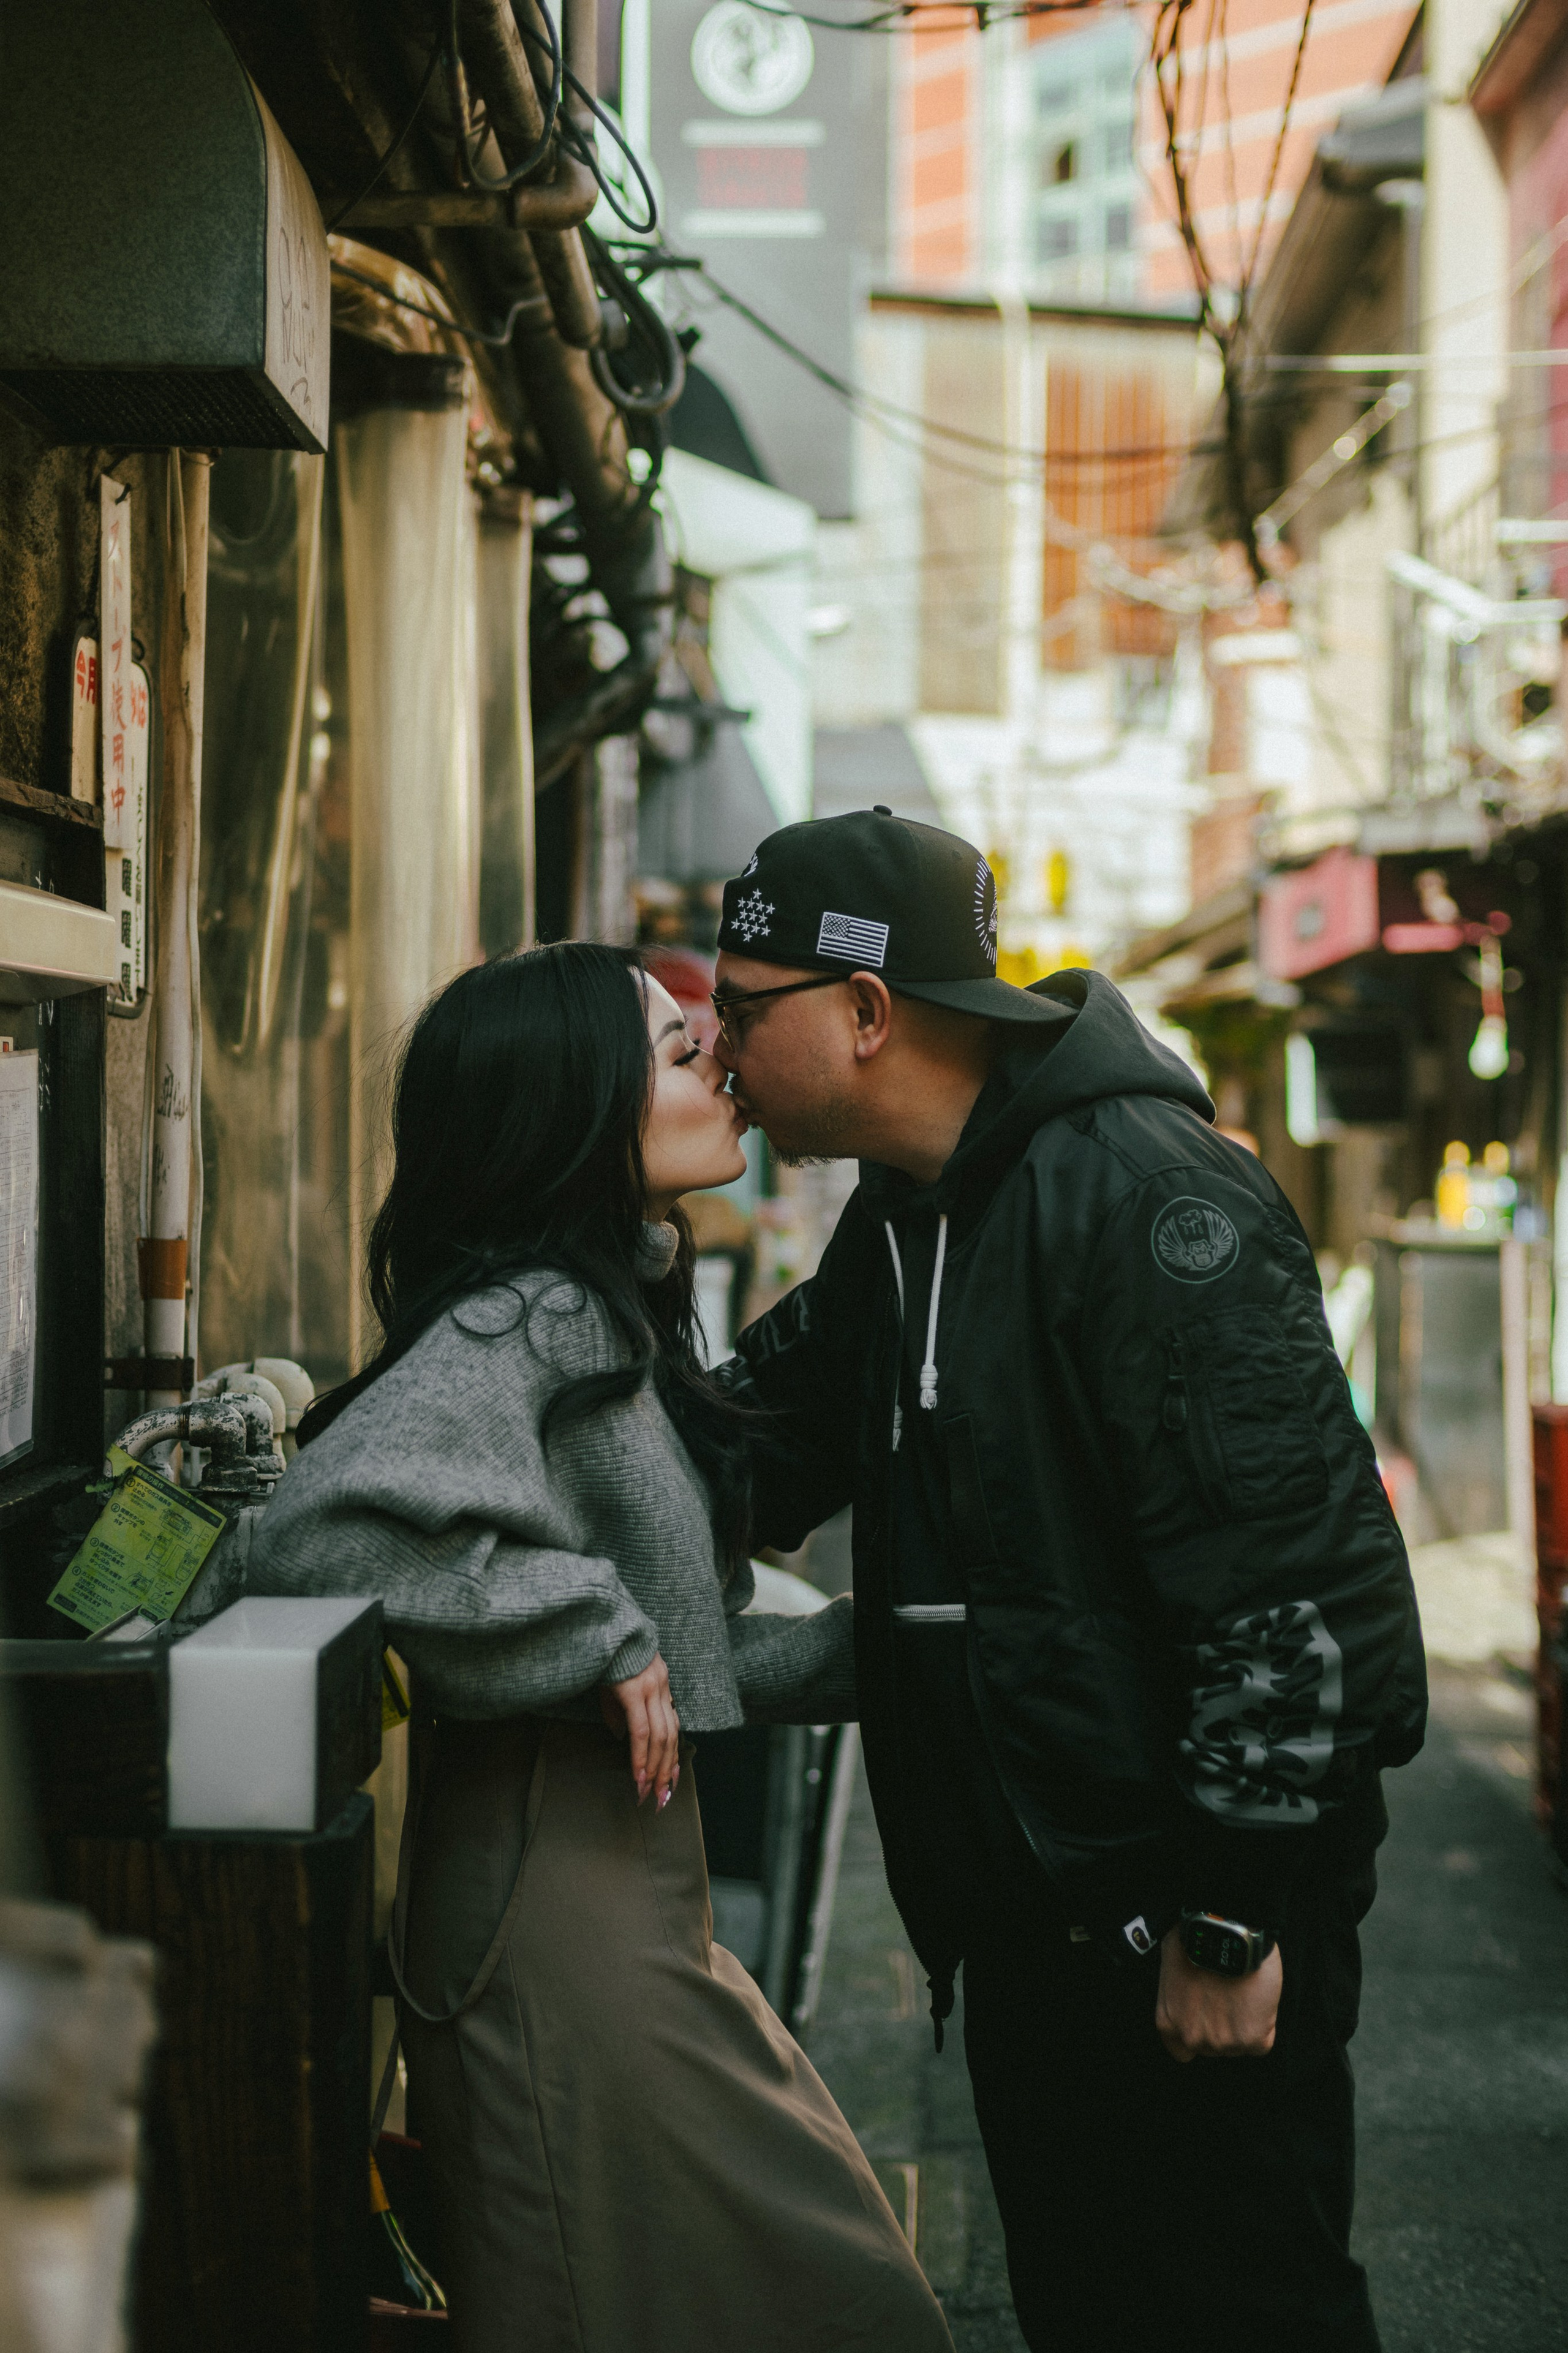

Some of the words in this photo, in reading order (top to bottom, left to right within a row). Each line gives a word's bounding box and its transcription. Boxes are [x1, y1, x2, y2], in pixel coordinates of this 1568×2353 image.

[132, 1487, 146, 1498] 止める
[113, 1517, 123, 1526] 外す
[116, 1513, 138, 1528] キャップを
